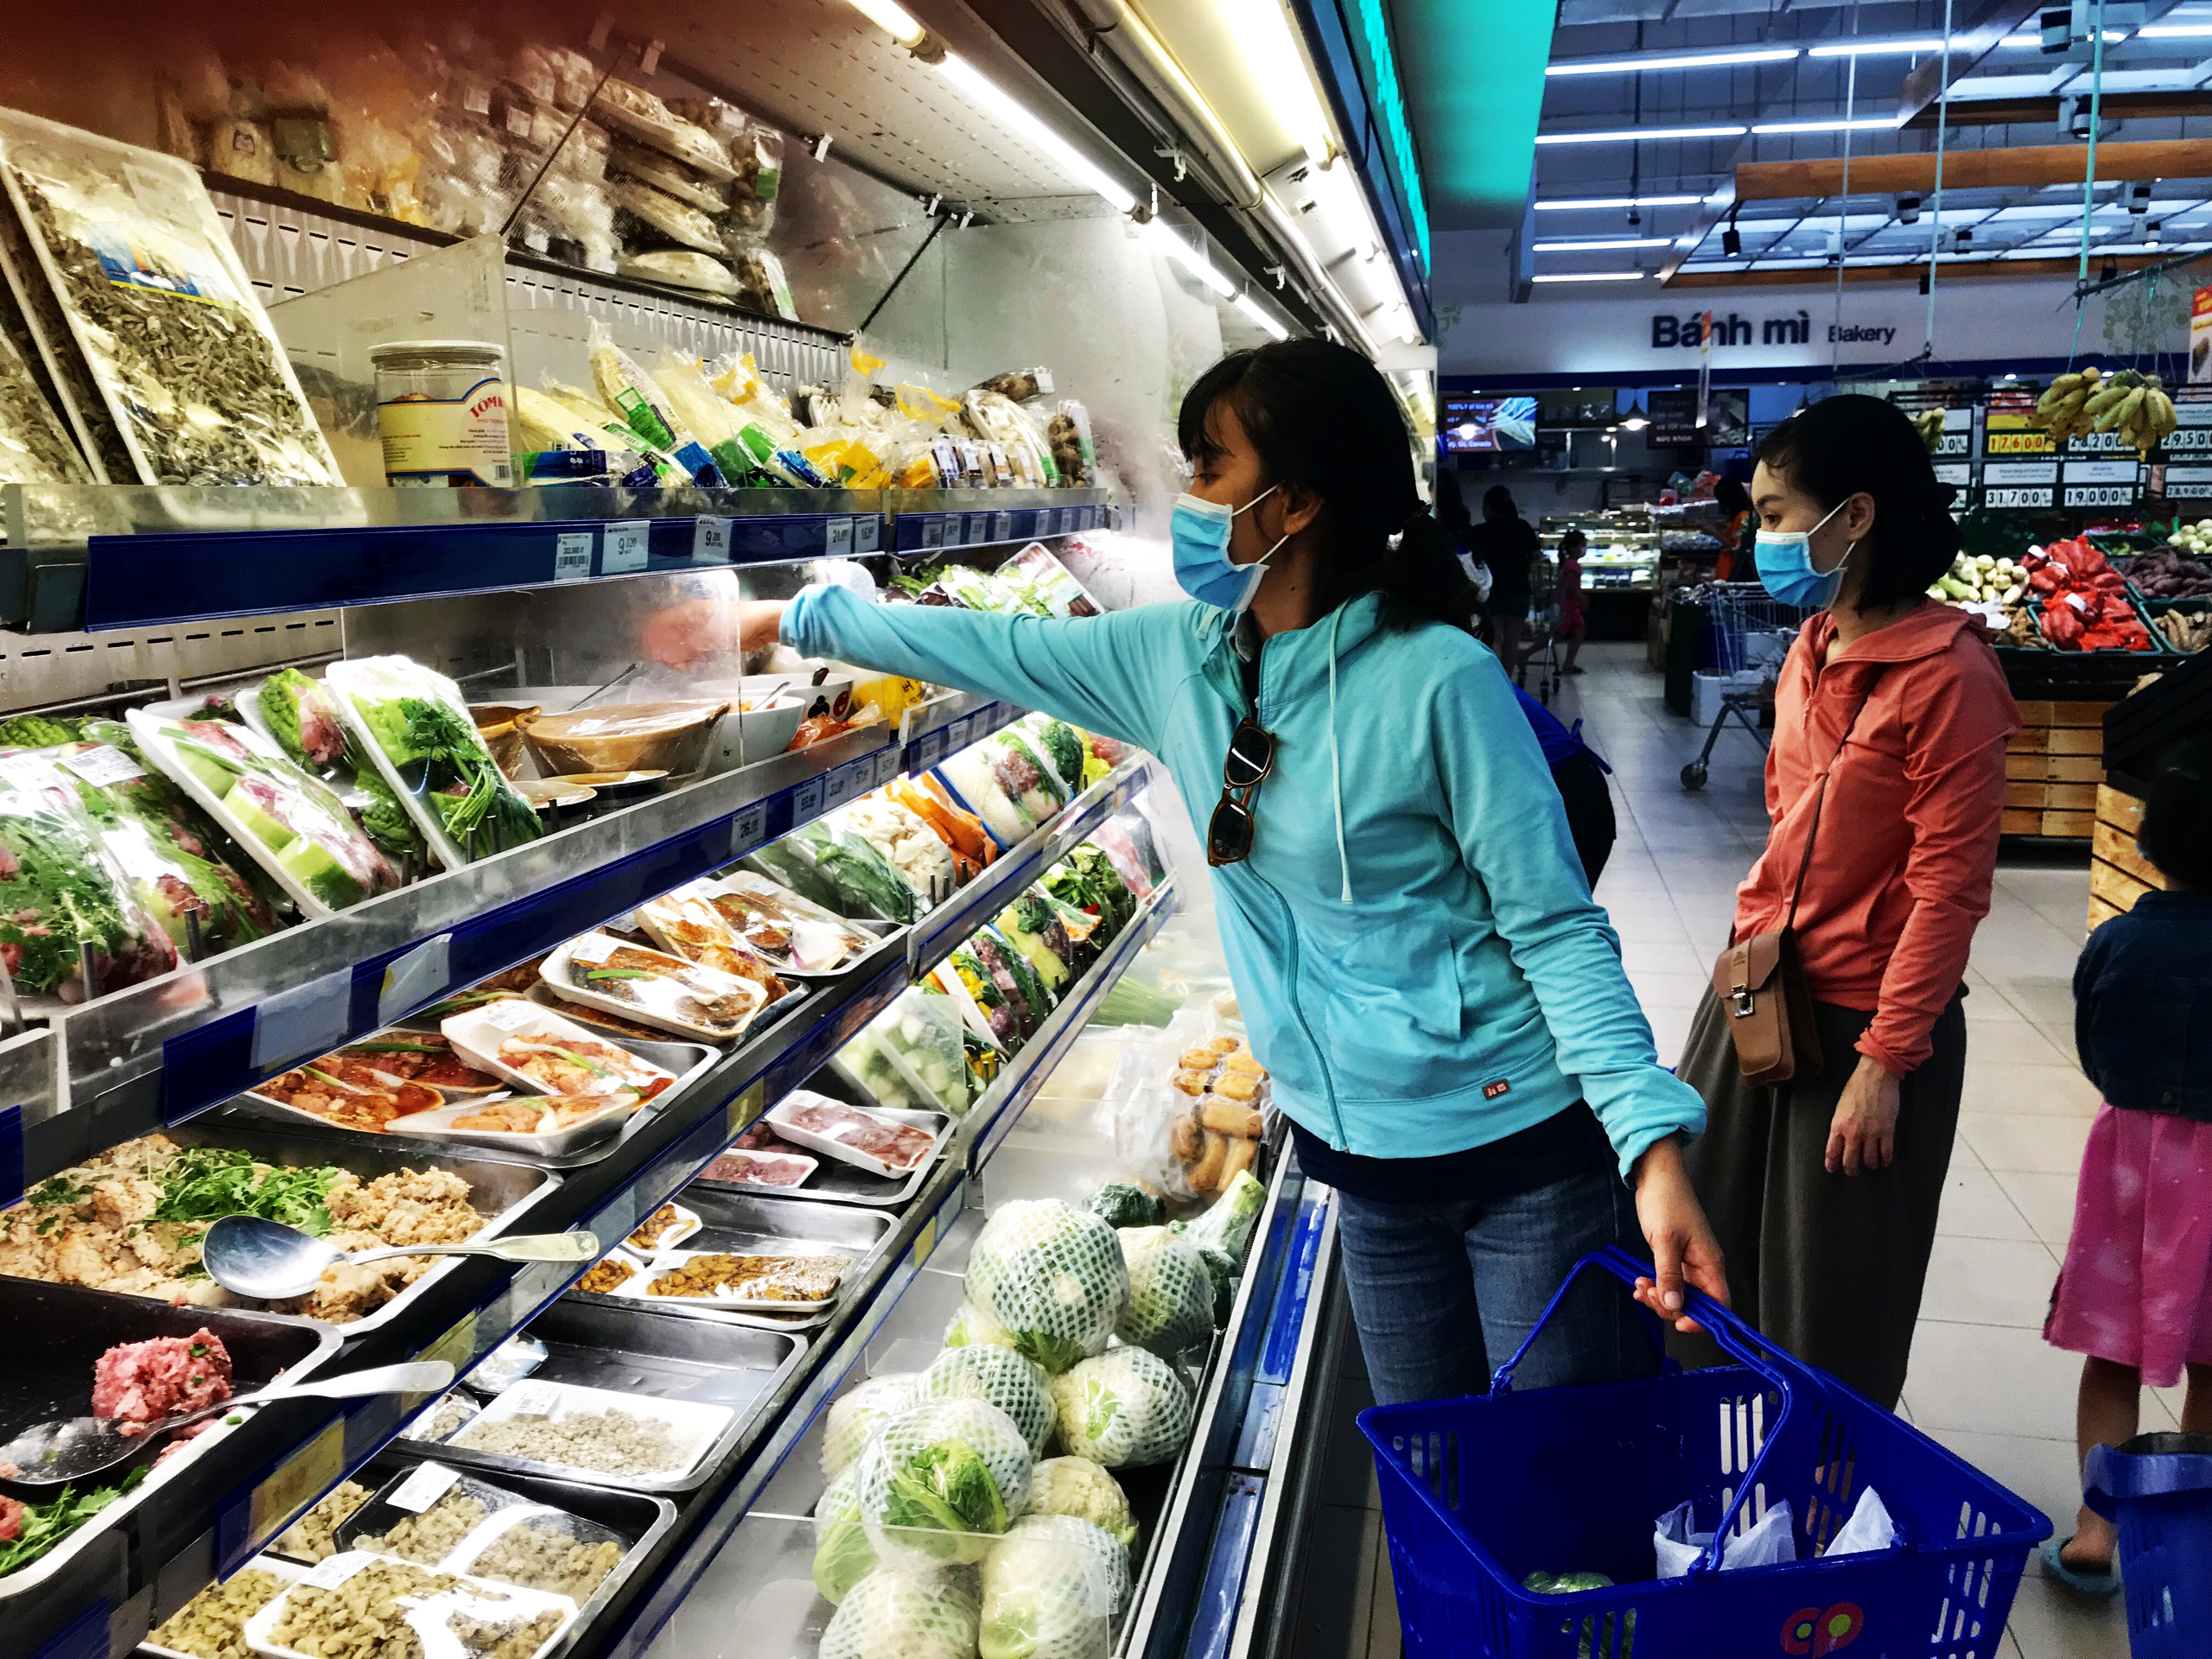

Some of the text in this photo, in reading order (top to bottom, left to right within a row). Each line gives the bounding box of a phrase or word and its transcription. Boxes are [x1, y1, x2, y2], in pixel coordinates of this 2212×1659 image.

[1652, 310, 1810, 347] Bánh mì
[1827, 325, 1896, 346] Bakery
